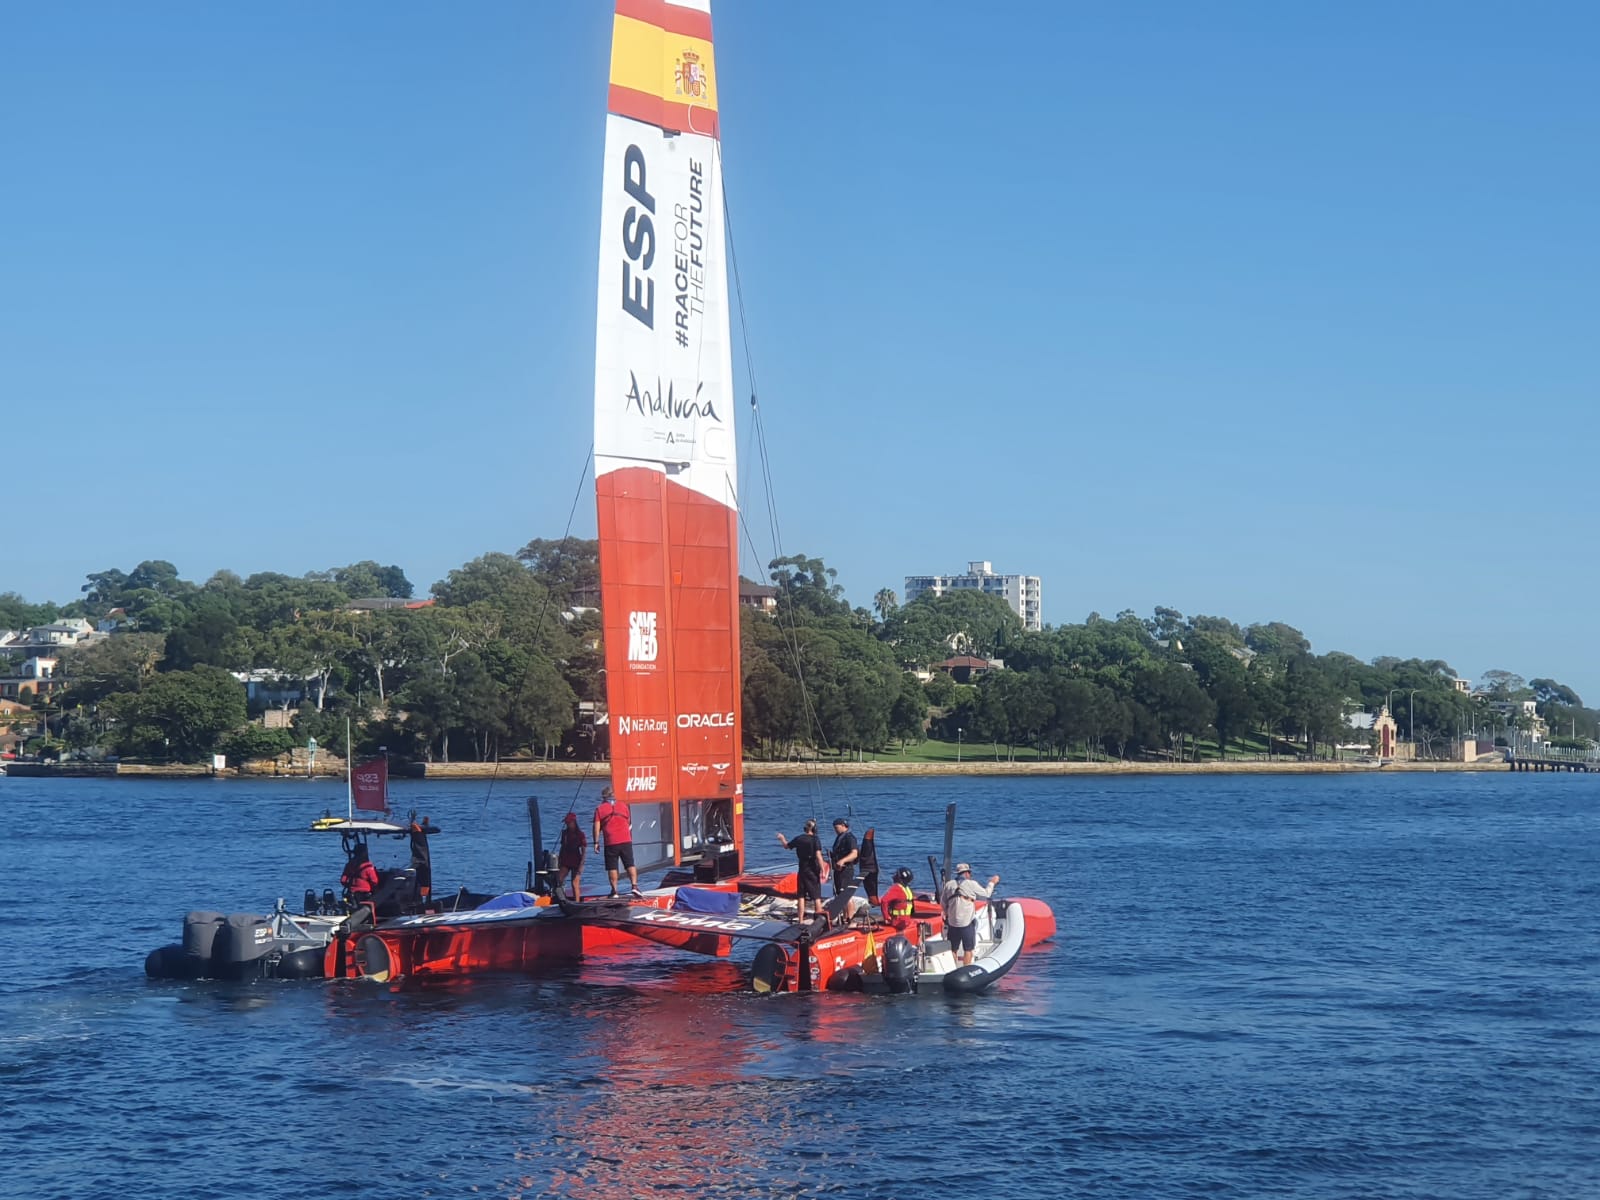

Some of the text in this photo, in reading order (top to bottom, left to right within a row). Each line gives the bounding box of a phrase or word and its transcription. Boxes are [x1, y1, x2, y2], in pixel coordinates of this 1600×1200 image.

[622, 144, 656, 330] ESP
[629, 611, 657, 636] SAVE
[628, 634, 658, 661] MED
[677, 712, 735, 728] ORACLE
[626, 777, 657, 792] KPMG
